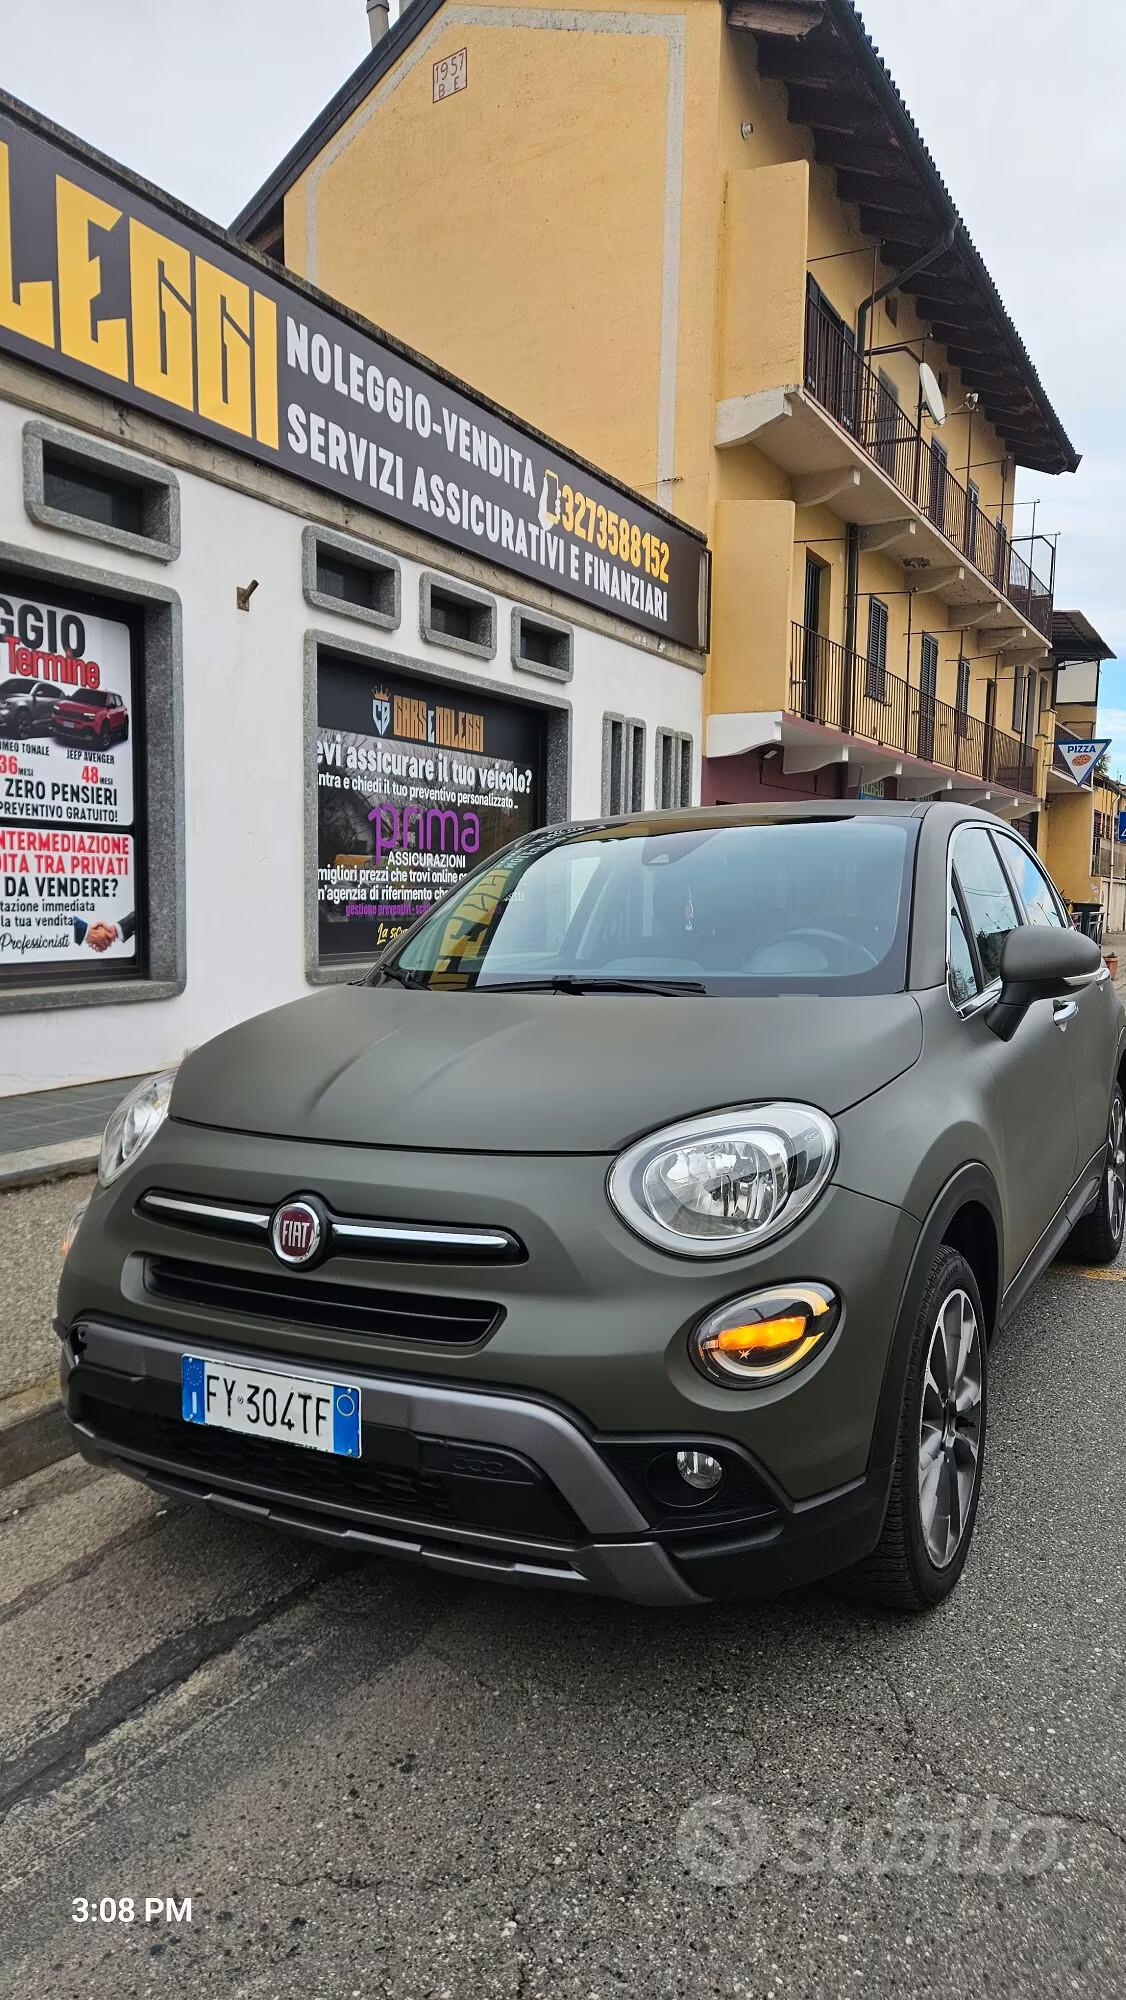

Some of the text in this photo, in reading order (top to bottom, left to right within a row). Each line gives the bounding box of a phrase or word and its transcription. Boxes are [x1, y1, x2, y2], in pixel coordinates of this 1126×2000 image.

[436, 52, 464, 83] 1957
[286, 315, 536, 499] NOLEGGIO-VENDITA
[287, 402, 668, 622] SERVIZI ASSICURATIVI E FINANZIARI
[561, 484, 670, 584] 3273588152
[4, 634, 100, 689] Termine
[435, 705, 484, 753] NOLEGGI
[0, 741, 50, 757] MEO TONALE
[67, 749, 115, 765] JEEP AVENGER
[1067, 745, 1096, 753] PIZZA
[81, 765, 99, 785] 48
[346, 741, 435, 781] assicurare
[438, 752, 449, 783] il
[452, 759, 476, 786] tuo
[478, 762, 532, 794] veicolo?
[4, 778, 118, 807] ZERO PENSIERI
[318, 771, 341, 788] ntra
[343, 776, 350, 790] e
[351, 775, 382, 794] chiedi
[384, 779, 391, 795] il
[392, 782, 408, 797] tuo
[409, 784, 457, 803] preventivo
[66, 806, 118, 823] GRATUITO!
[367, 802, 480, 865] prima
[0, 853, 128, 876] ITA TRA PRIVATI
[387, 851, 466, 869] ASSICURAZIONI
[317, 864, 358, 885] migliori
[359, 866, 389, 886] prezzi
[391, 867, 408, 881] che
[409, 868, 430, 883] trovi
[432, 868, 458, 883] online
[4, 876, 119, 898] DA VENDERE?
[369, 884, 379, 901] di
[381, 885, 432, 901] riferimento
[0, 898, 95, 912] tazione immediata
[15, 914, 32, 927] tua
[34, 913, 73, 927] vendita
[282, 1219, 311, 1248] FIAT
